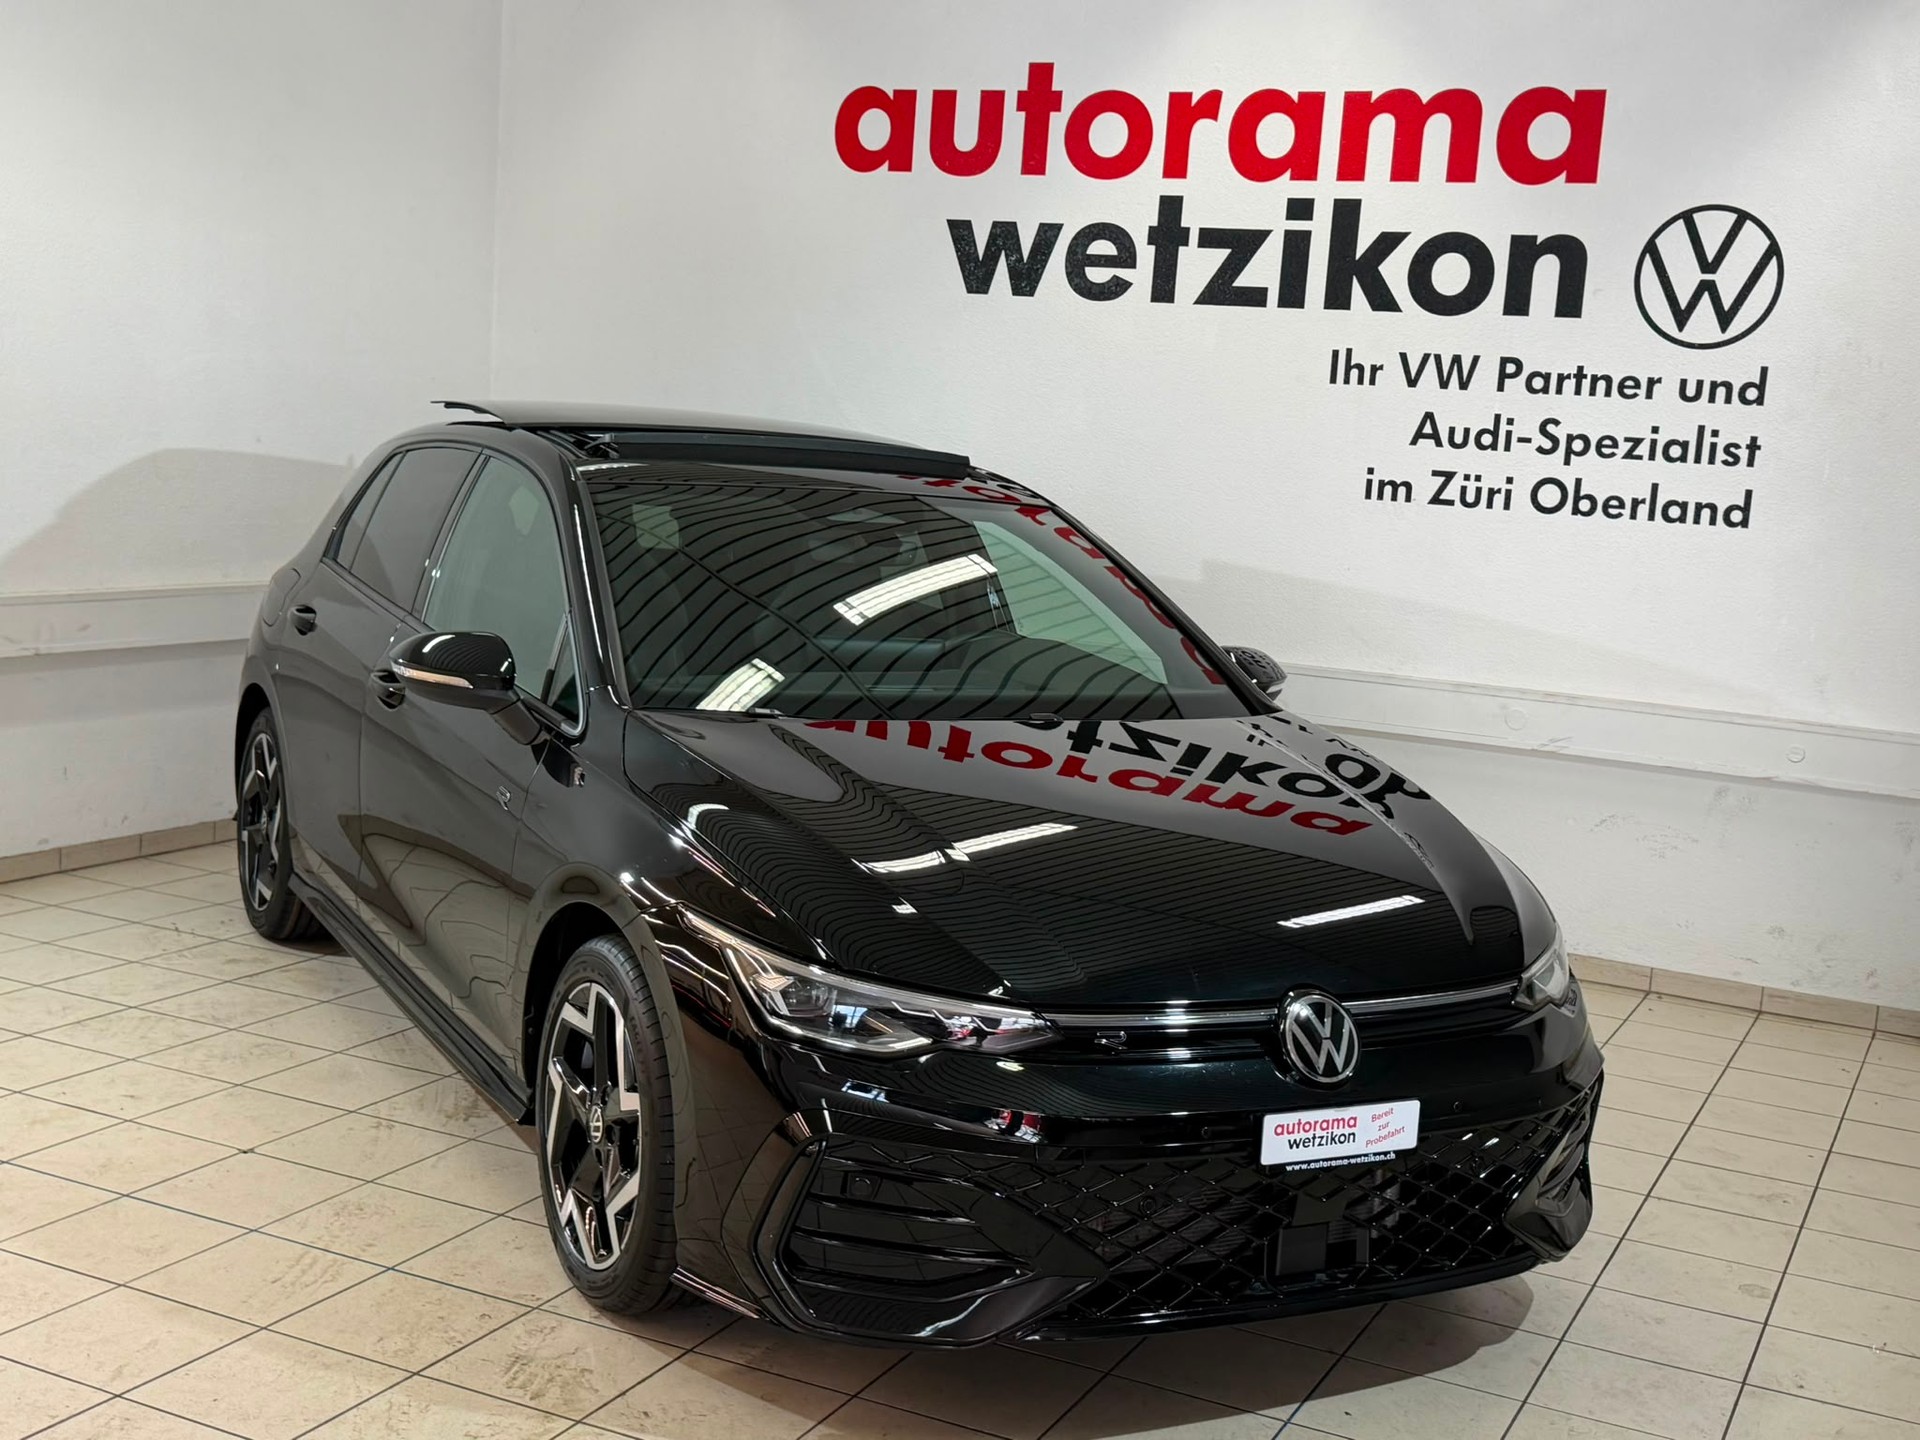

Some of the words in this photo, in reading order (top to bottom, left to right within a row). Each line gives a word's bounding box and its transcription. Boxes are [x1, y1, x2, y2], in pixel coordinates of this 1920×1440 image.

[834, 62, 1608, 187] autorama
[946, 194, 1588, 319] wetzikon
[1329, 349, 1384, 388] Ihr
[1398, 351, 1481, 391] VW
[1496, 356, 1663, 403] Partner
[1678, 366, 1769, 407] und
[1408, 411, 1762, 468] Audi-Spezialist
[1364, 467, 1413, 503] im
[1427, 469, 1514, 511] Züri
[1530, 477, 1753, 529] Oberland
[1274, 1115, 1358, 1137] autorama
[1371, 1107, 1394, 1123] Bereit
[1377, 1120, 1390, 1132] zur
[1287, 1131, 1356, 1150] wetzikon
[1365, 1126, 1405, 1148] Probefahrt
[1285, 1151, 1396, 1172] www.autorama-wetzikon.ch
